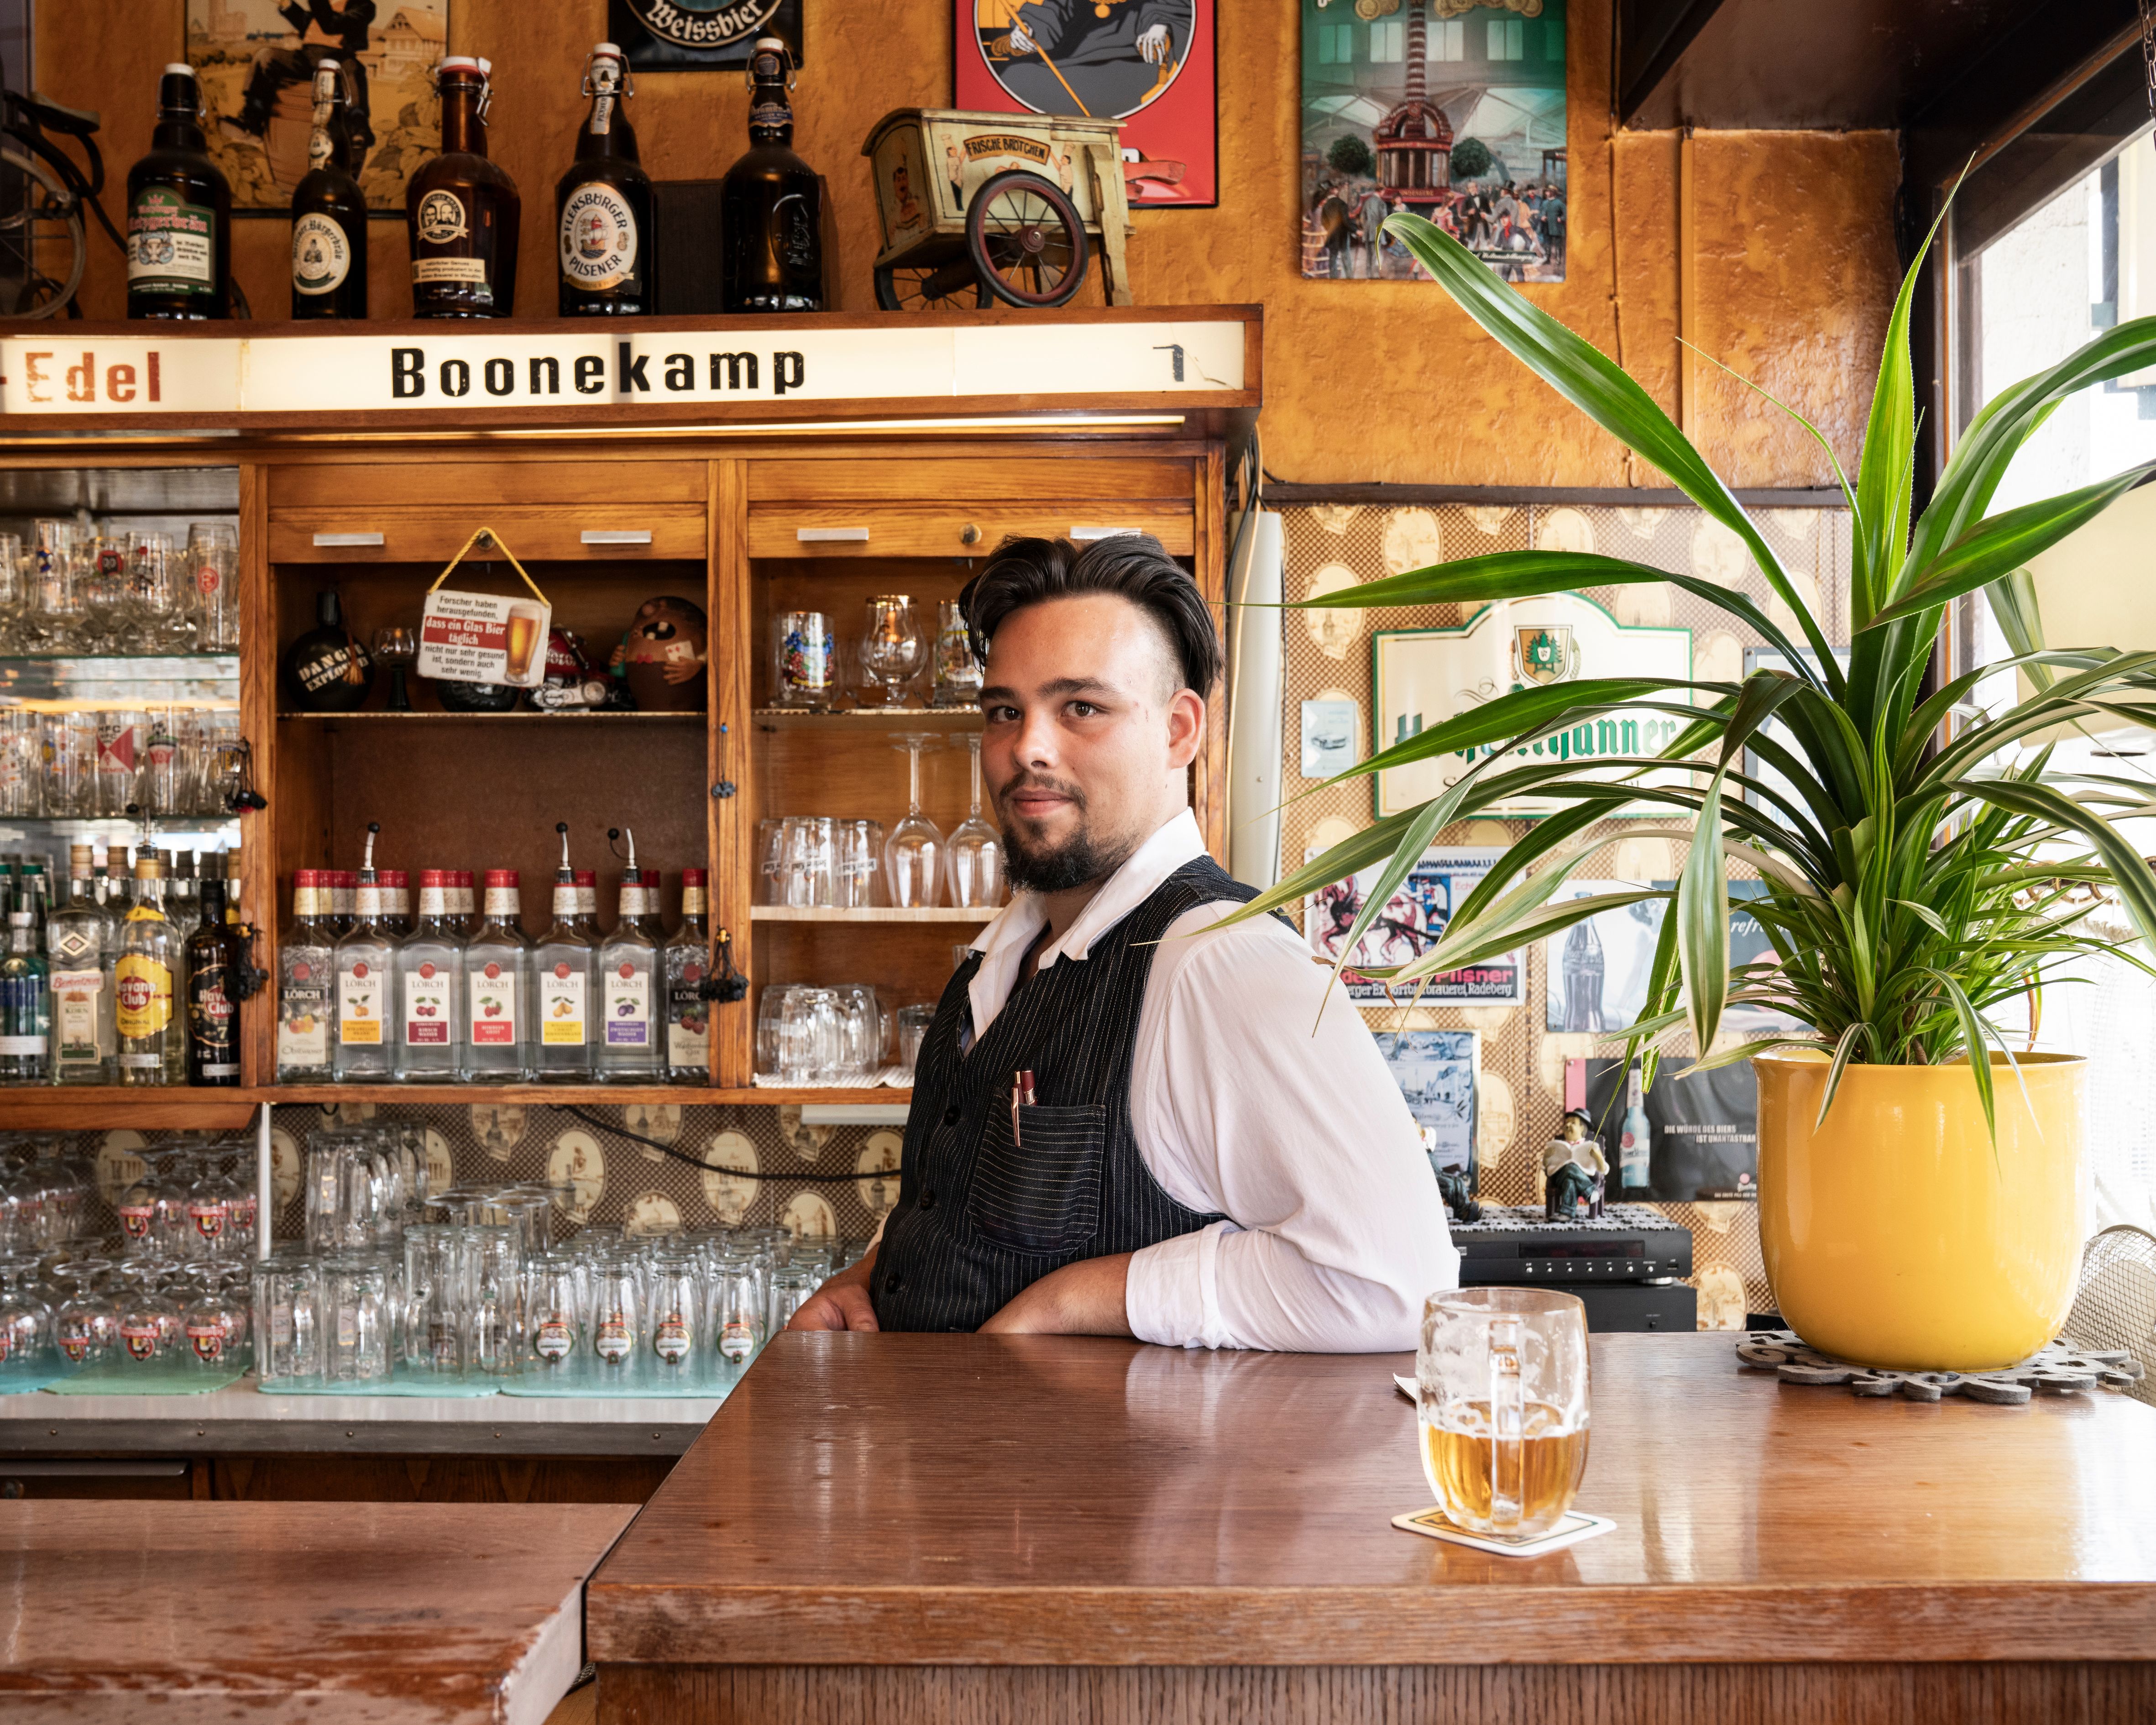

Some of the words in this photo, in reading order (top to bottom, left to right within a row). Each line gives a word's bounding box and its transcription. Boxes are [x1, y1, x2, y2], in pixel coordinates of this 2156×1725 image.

[646, 0, 763, 41] Weissbier
[966, 138, 1001, 157] FRISCHE
[570, 254, 622, 277] PILSENER
[391, 342, 805, 398] Boonekamp
[440, 596, 472, 606] Forscher
[475, 598, 497, 608] haben
[437, 605, 498, 620] herausgefunden,
[426, 617, 446, 629] dass
[447, 619, 461, 630] ein
[463, 621, 484, 633] Glas
[485, 623, 505, 635] Bier
[448, 633, 478, 646] täglich
[424, 645, 443, 654] nicht
[479, 650, 505, 661] gesund
[445, 658, 475, 666] sondern
[477, 660, 495, 668] auch
[199, 989, 226, 1003] Hav
[674, 991, 700, 1001] LÖRC
[1467, 982, 1512, 997] Radeberg
[121, 992, 147, 1006] Club
[207, 1002, 234, 1015] Club
[217, 1026, 228, 1040] 7
[1664, 1124, 1676, 1134] DIE
[1676, 1123, 1702, 1134] WÜRDE
[1696, 1134, 1707, 1143] IST
